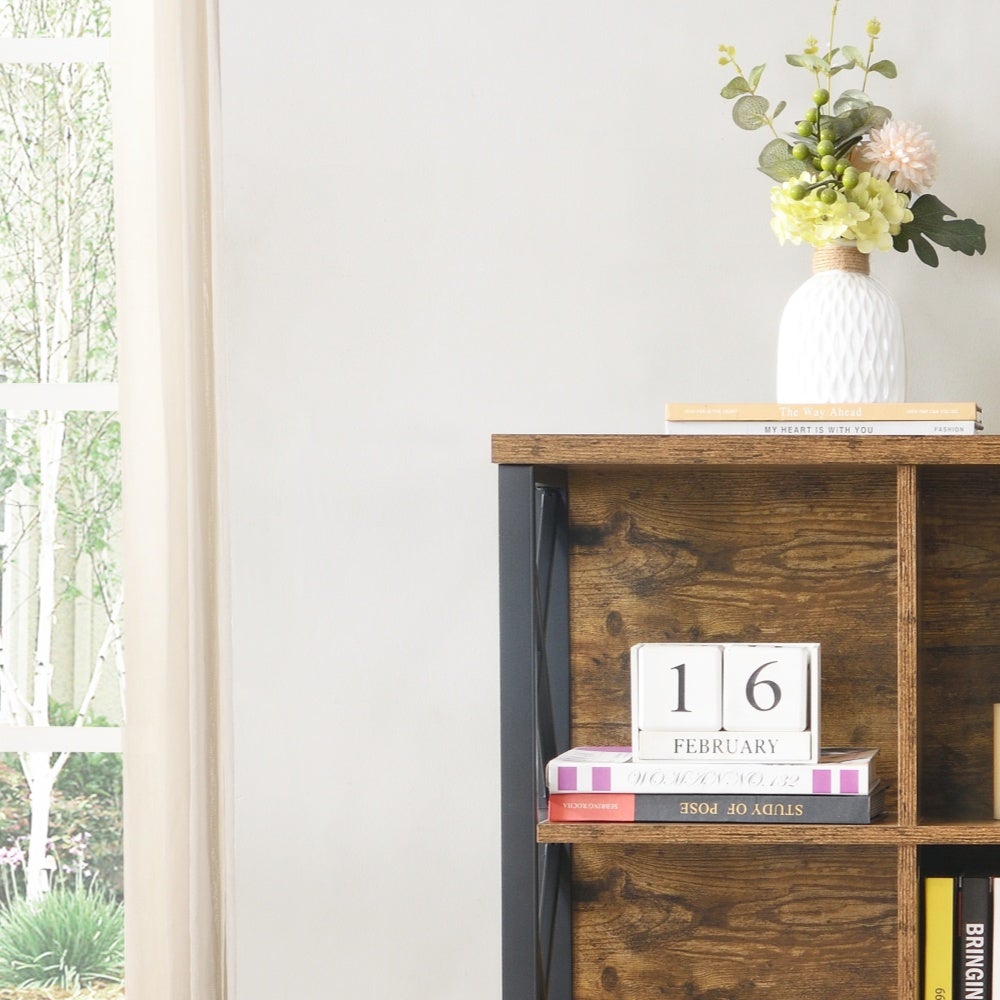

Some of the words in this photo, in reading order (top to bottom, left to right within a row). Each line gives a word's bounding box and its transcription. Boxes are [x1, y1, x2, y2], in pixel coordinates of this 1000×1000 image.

[779, 407, 800, 418] The
[803, 407, 825, 419] Way
[828, 407, 862, 418] Ahead
[764, 426, 777, 434] MY
[781, 426, 812, 434] HEART
[814, 426, 825, 434] IS
[854, 426, 874, 434] YOU
[670, 663, 692, 713] 1
[745, 660, 782, 712] 6
[673, 738, 779, 754] FEBRUARY
[679, 802, 718, 815] POSE
[727, 803, 748, 815] OF
[752, 804, 804, 816] STUDY
